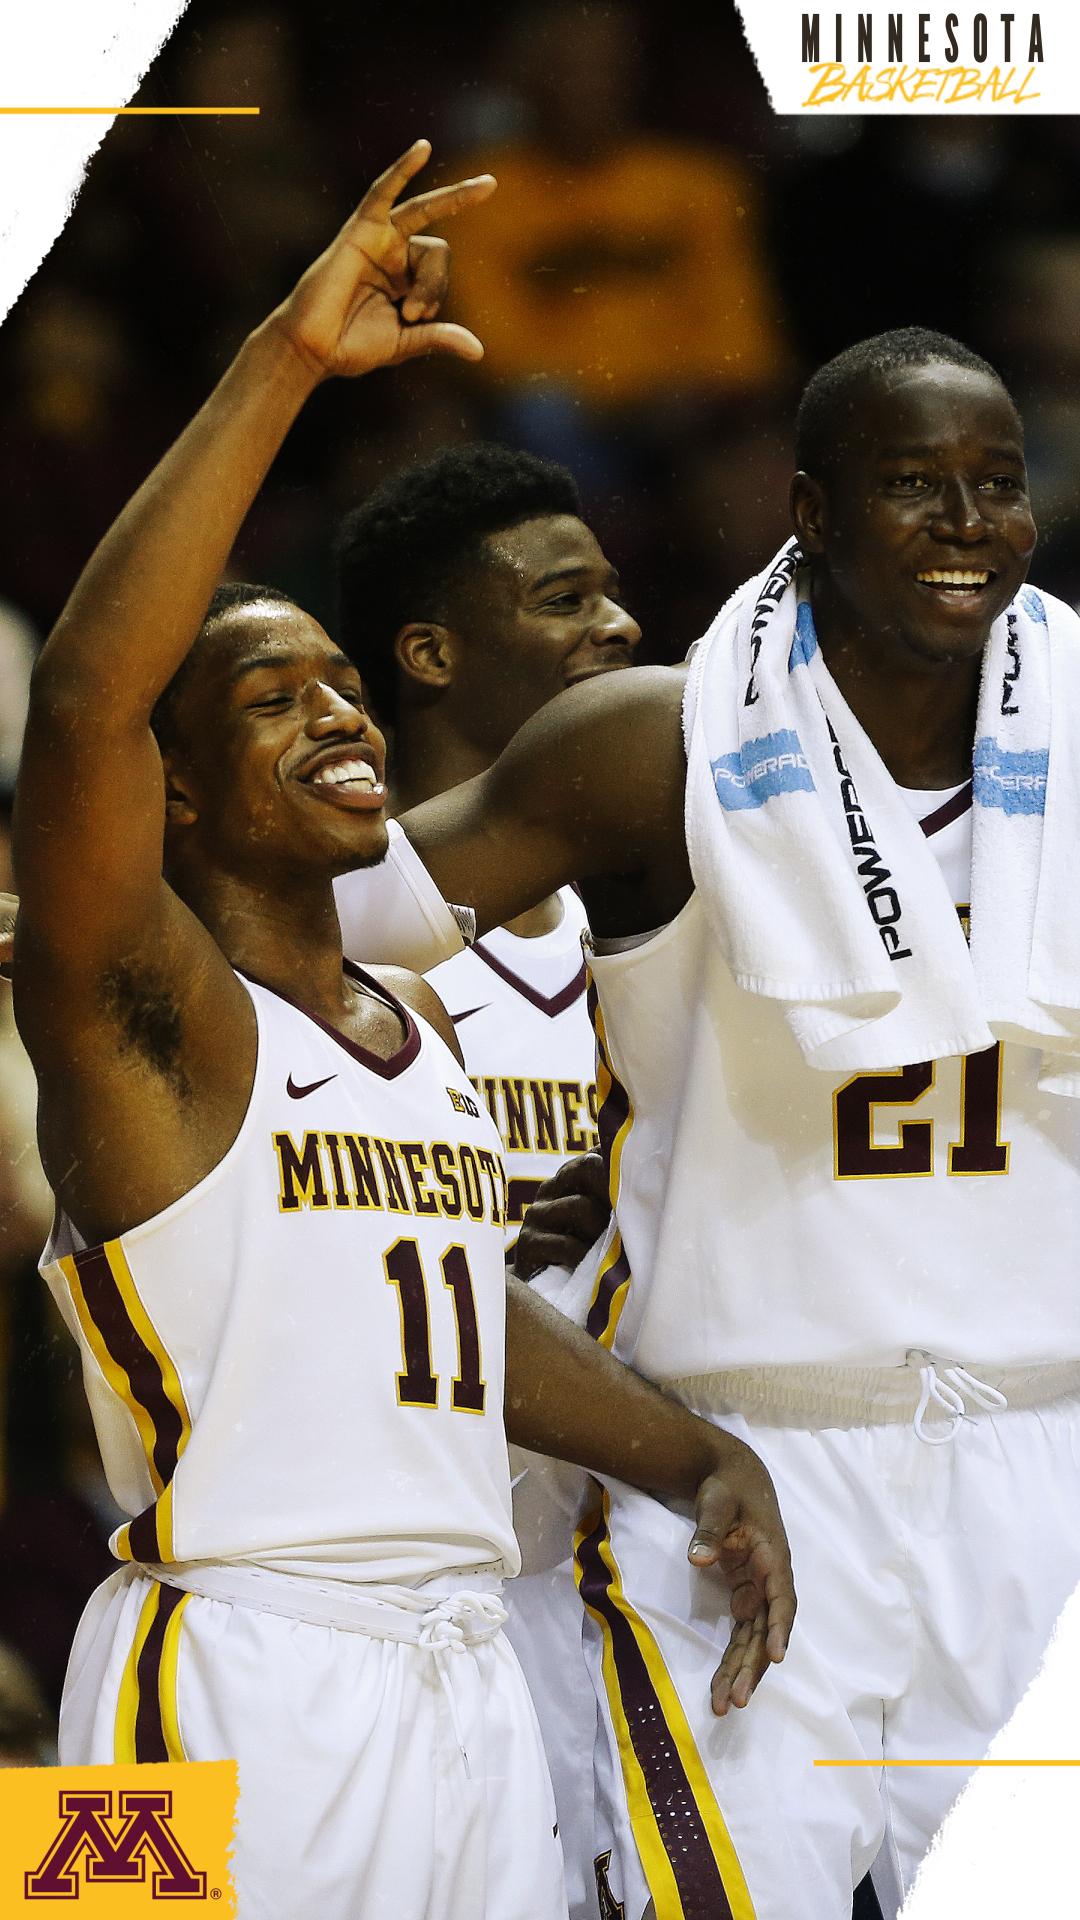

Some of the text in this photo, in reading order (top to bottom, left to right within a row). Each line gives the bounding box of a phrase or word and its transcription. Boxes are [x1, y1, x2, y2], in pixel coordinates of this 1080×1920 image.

[271, 1129, 507, 1230] MINNESOT
[832, 1040, 1011, 1180] 21
[381, 1236, 486, 1416] 11
